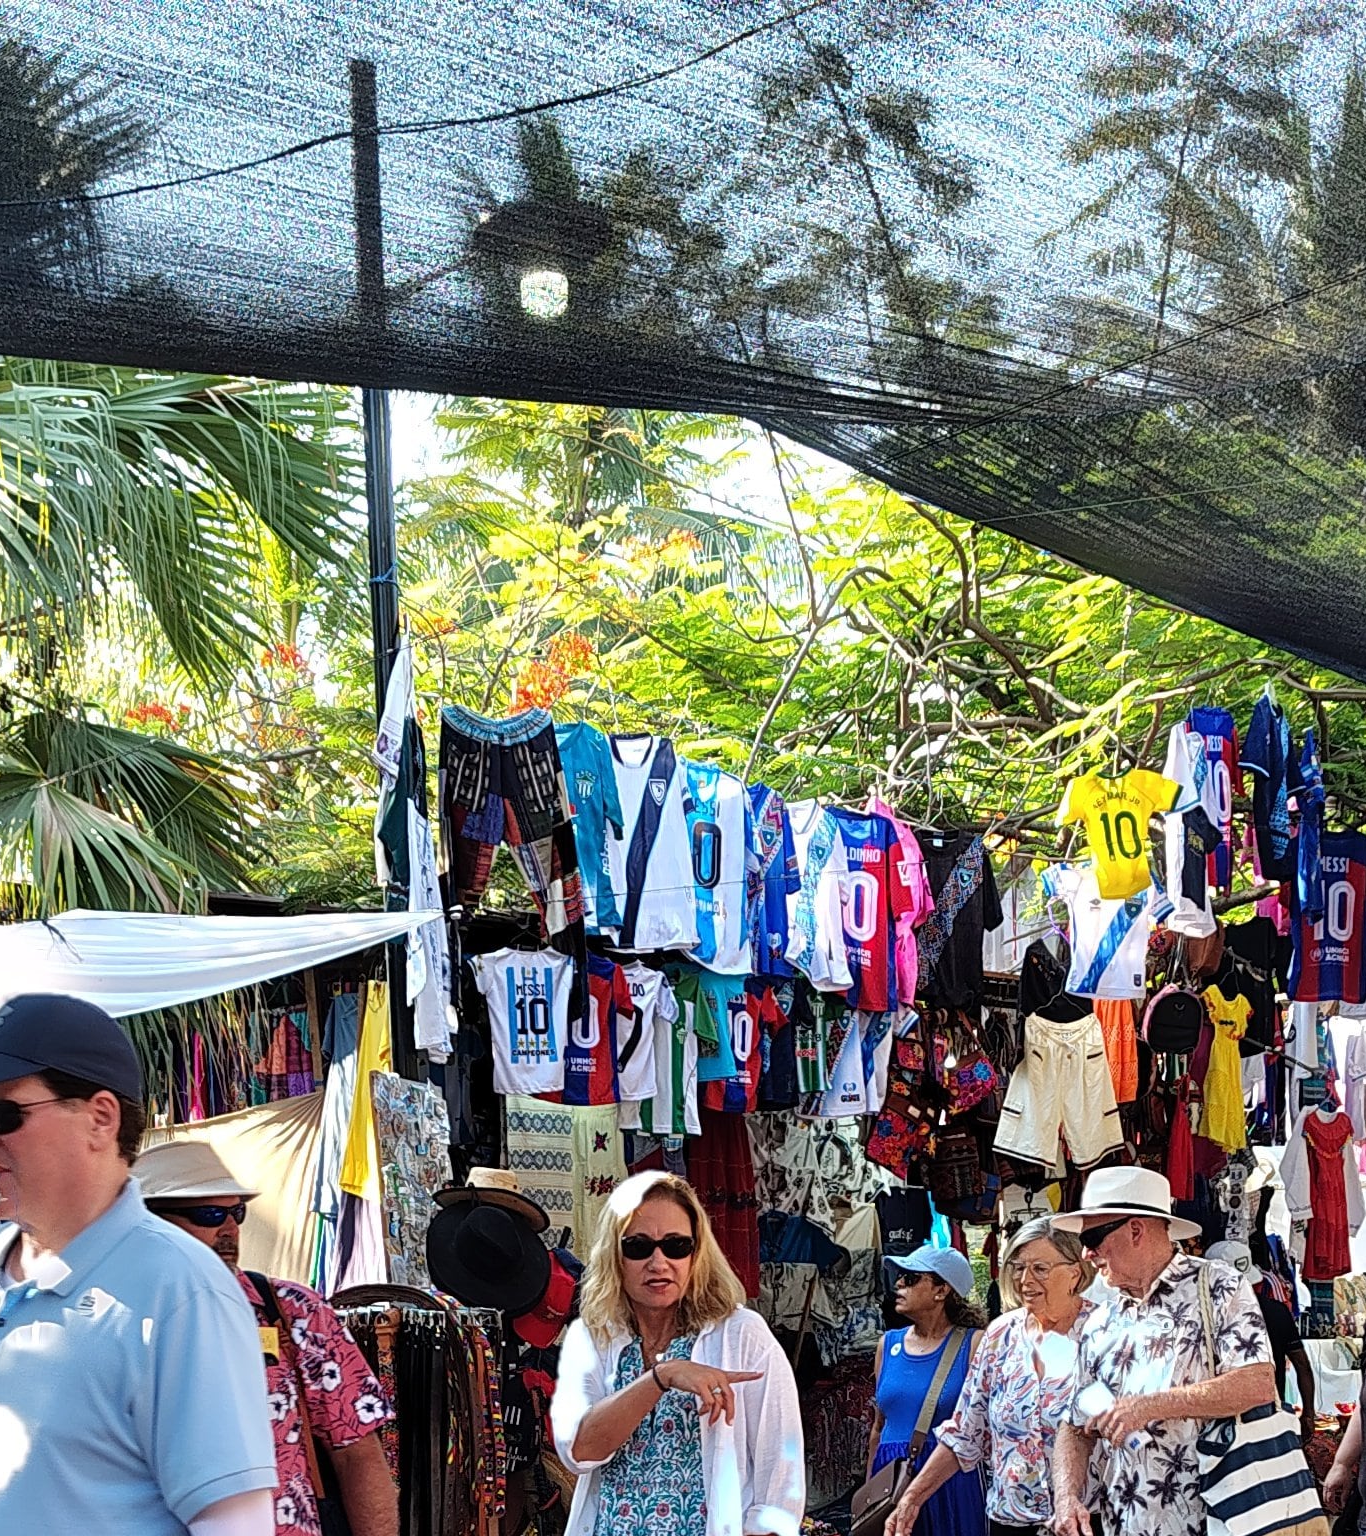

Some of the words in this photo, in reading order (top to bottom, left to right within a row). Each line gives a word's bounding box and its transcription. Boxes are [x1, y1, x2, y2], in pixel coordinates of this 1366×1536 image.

[1100, 811, 1143, 862] 10
[516, 984, 546, 997] MESSI
[515, 998, 550, 1035] 10
[512, 1049, 556, 1057] CAMPEONES
